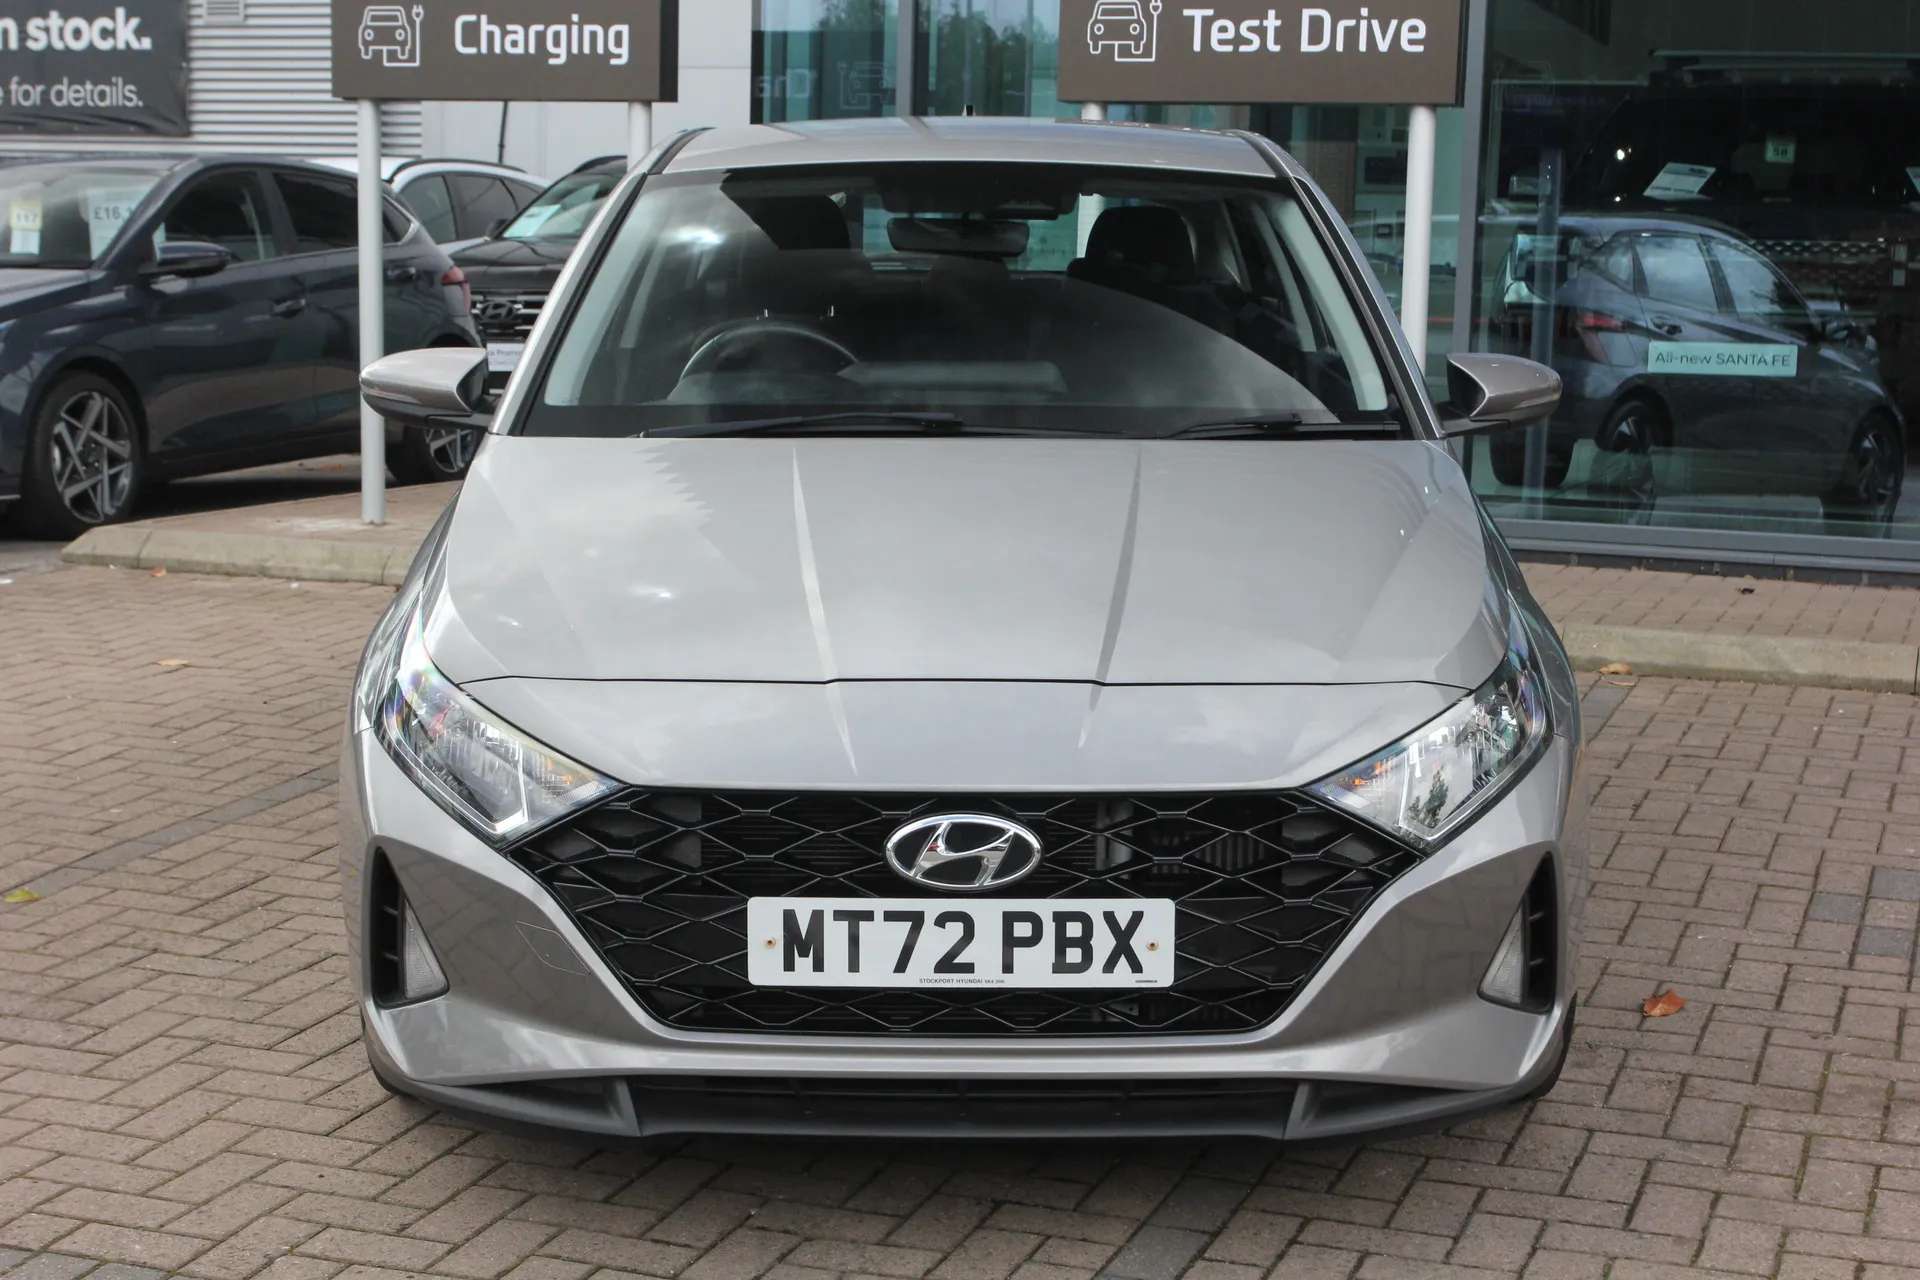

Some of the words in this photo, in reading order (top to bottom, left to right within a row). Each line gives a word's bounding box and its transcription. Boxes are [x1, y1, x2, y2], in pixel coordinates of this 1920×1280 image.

[26, 7, 152, 50] stock.
[454, 13, 629, 64] Charging
[1183, 9, 1281, 52] Test
[1301, 8, 1426, 53] Drive
[10, 76, 44, 106] for
[50, 76, 143, 107] details.
[1655, 352, 1711, 365] All-new
[1716, 353, 1767, 366] SANTA
[1772, 354, 1791, 366] FE
[783, 909, 975, 974] MT72
[1001, 910, 1144, 974] PBX
